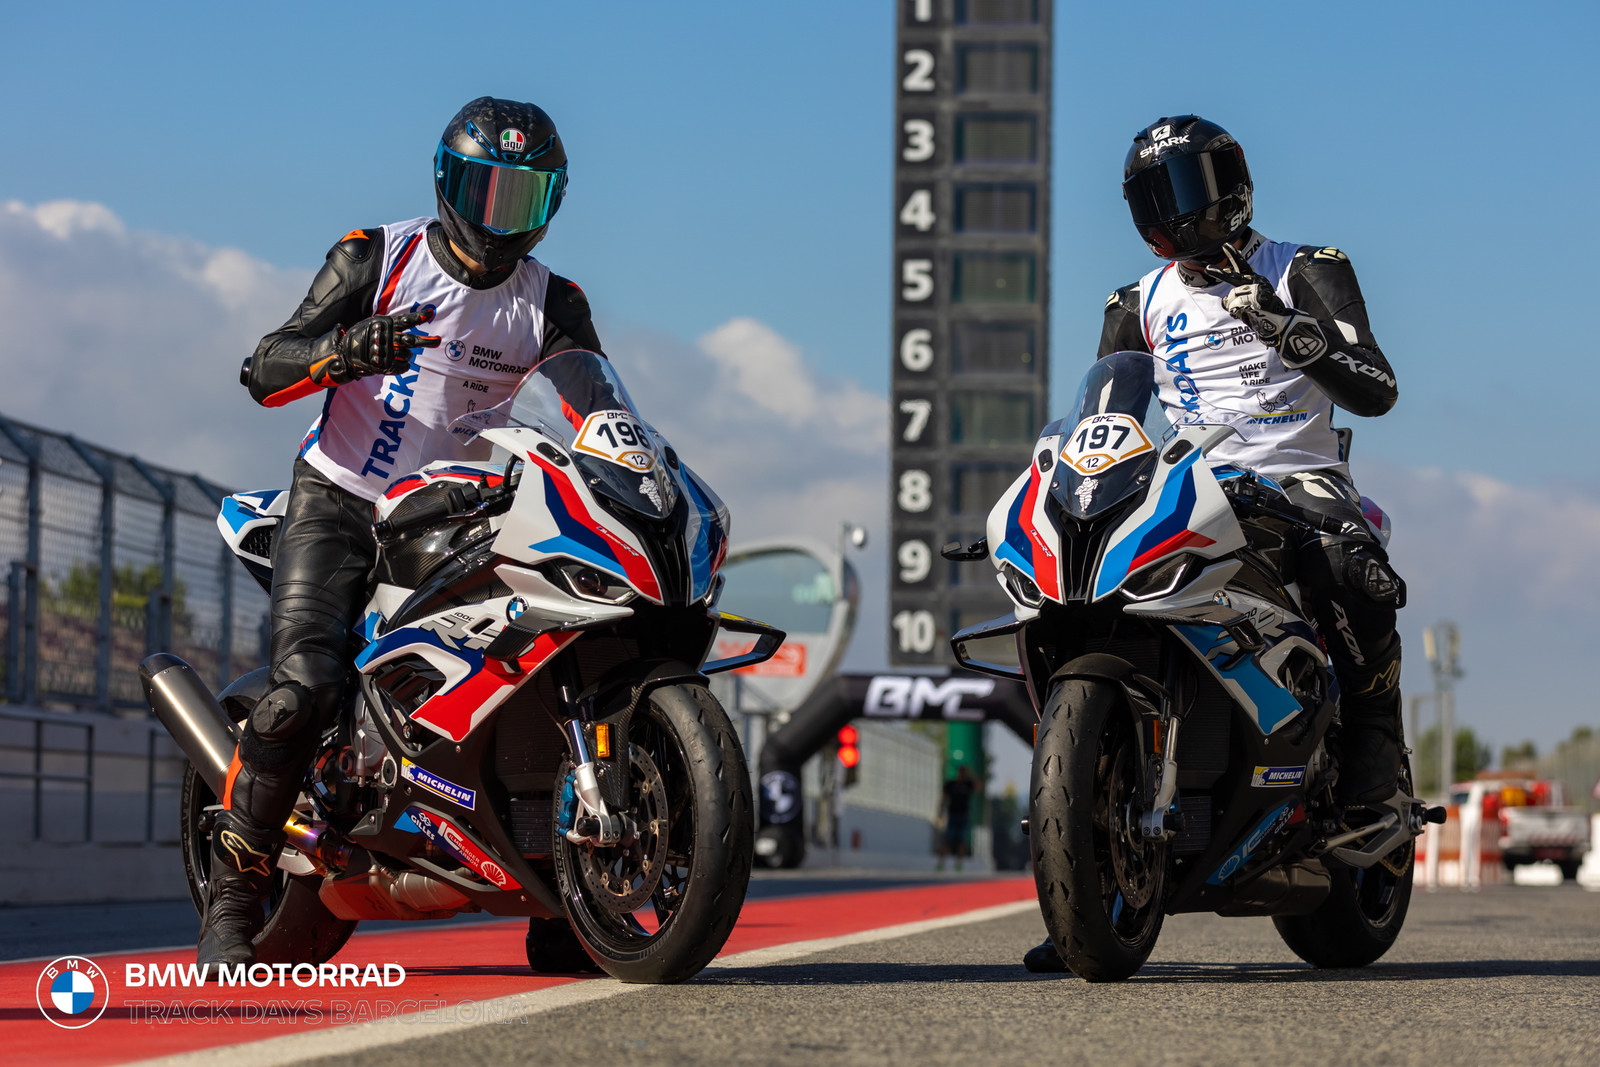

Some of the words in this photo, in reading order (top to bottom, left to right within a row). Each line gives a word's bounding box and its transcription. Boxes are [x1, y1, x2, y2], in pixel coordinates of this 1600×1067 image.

[903, 49, 936, 91] 2
[902, 119, 935, 162] 3
[1140, 134, 1191, 158] SHARK
[899, 189, 936, 232] 4
[901, 259, 934, 302] 5
[472, 345, 503, 360] BMW
[900, 328, 933, 372] 6
[1239, 362, 1267, 372] MAKE
[1241, 371, 1260, 379] LIFE
[1250, 377, 1271, 386] RIDE
[462, 380, 469, 388] A
[470, 382, 490, 393] RIDE
[607, 412, 628, 420] BMC
[900, 399, 933, 442] 7
[1091, 415, 1117, 424] BMC
[596, 421, 652, 451] 196
[1075, 424, 1131, 454] 197
[631, 455, 646, 466] 12
[1085, 457, 1099, 469] 12
[898, 469, 932, 512] 8
[898, 539, 932, 583] 9
[892, 610, 936, 653] 10
[863, 675, 996, 719] BMC
[417, 771, 472, 802] MICHELIN
[1268, 771, 1303, 780] MICHELIN
[410, 814, 436, 841] GILLES
